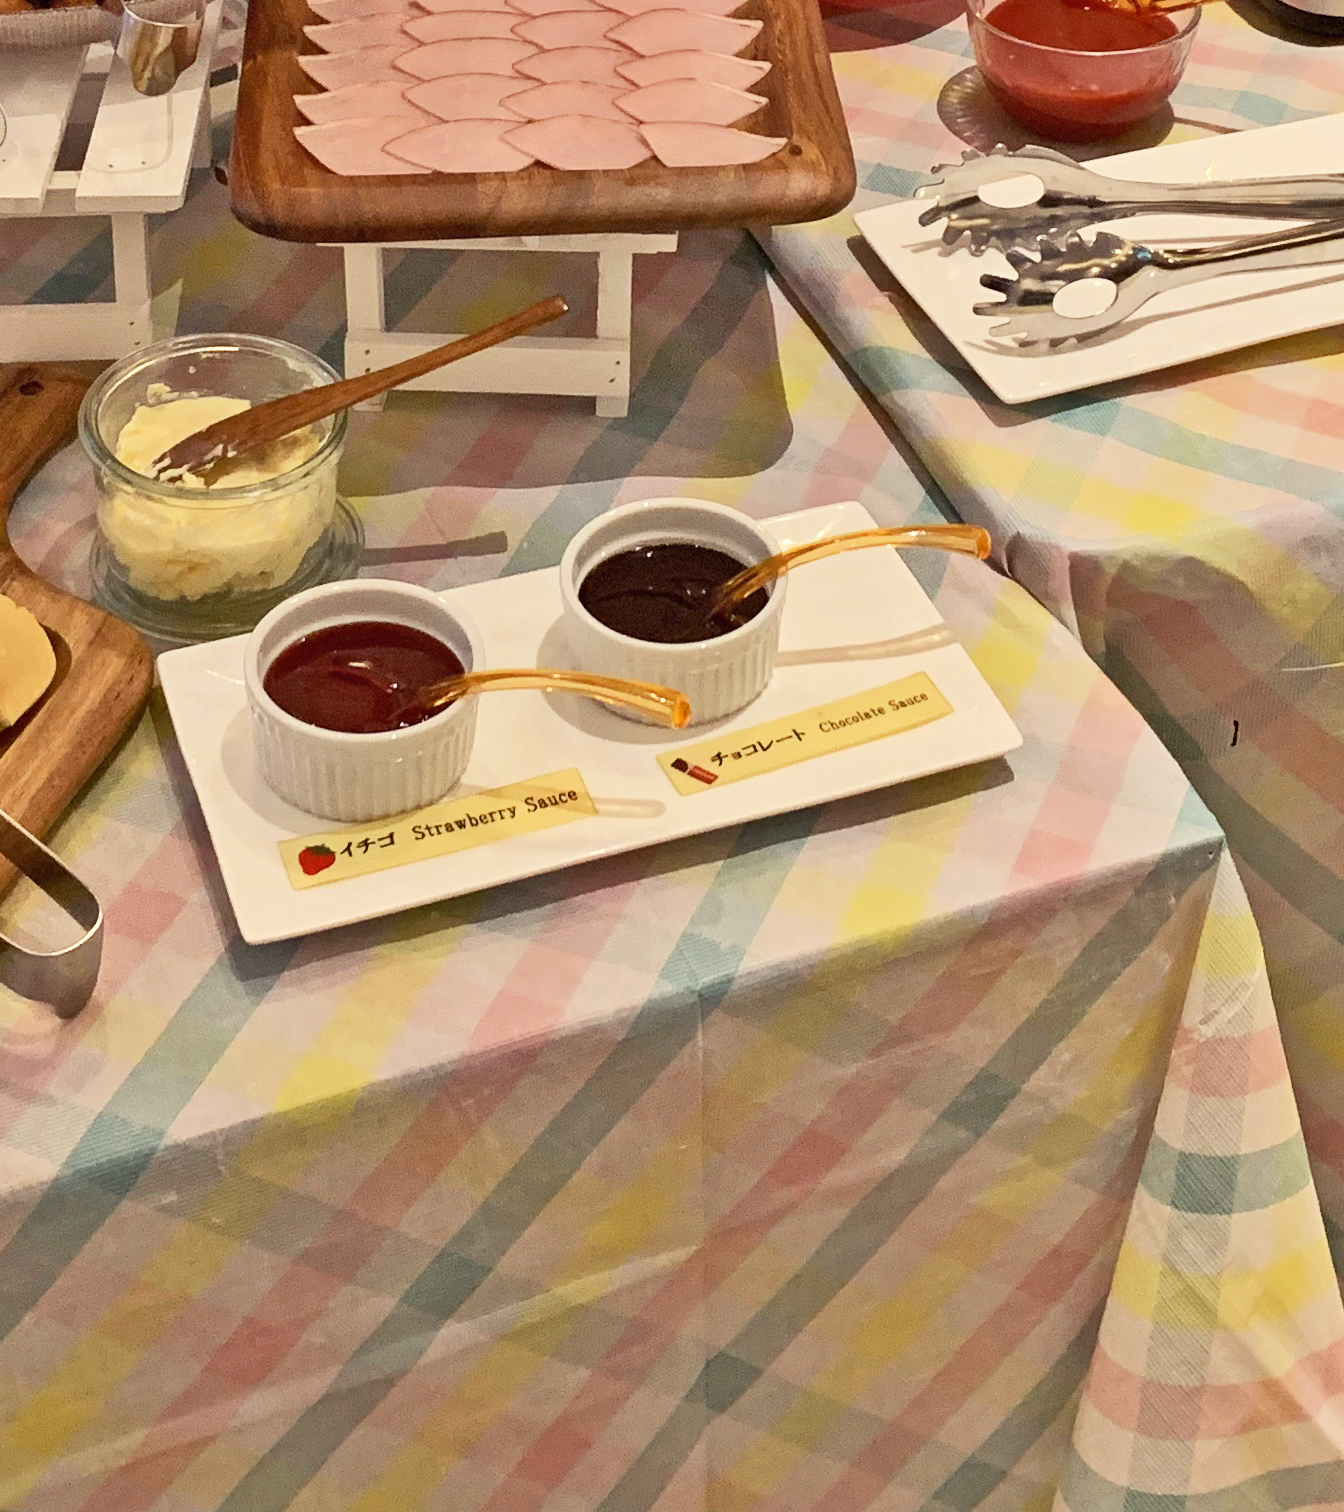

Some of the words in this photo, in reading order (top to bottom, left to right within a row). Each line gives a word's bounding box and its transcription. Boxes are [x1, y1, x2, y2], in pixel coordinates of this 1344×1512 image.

[710, 727, 806, 767] チョコレート
[818, 704, 886, 734] Chocolate
[888, 691, 930, 712] Sauce
[339, 831, 396, 858] イチゴ
[411, 805, 518, 841] Strawberry
[524, 789, 579, 813] Sauce
